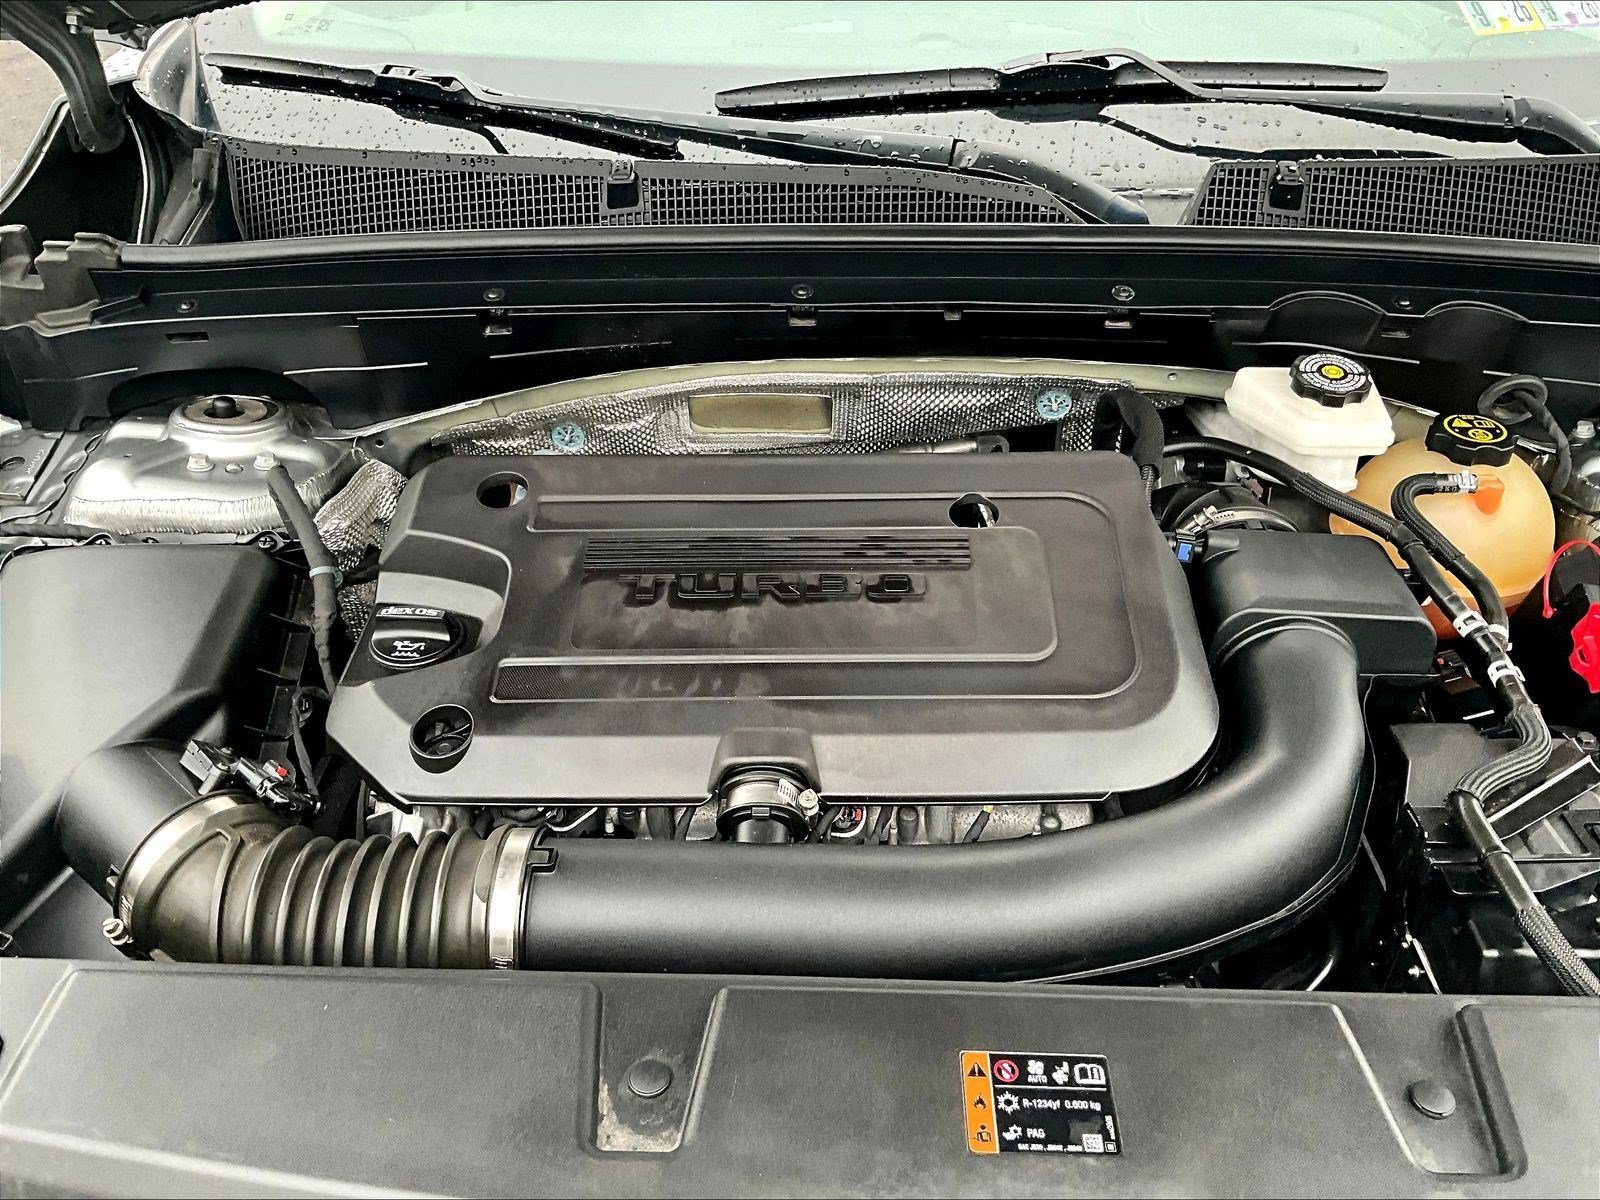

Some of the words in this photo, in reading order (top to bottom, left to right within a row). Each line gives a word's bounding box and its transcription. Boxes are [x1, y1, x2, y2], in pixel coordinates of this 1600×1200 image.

[618, 572, 928, 602] TURBO
[380, 606, 440, 616] dexos
[1028, 1074, 1048, 1083] AUTO
[1022, 1098, 1060, 1110] R-1234yf
[1090, 1101, 1101, 1111] kg
[1027, 1128, 1046, 1139] PAG
